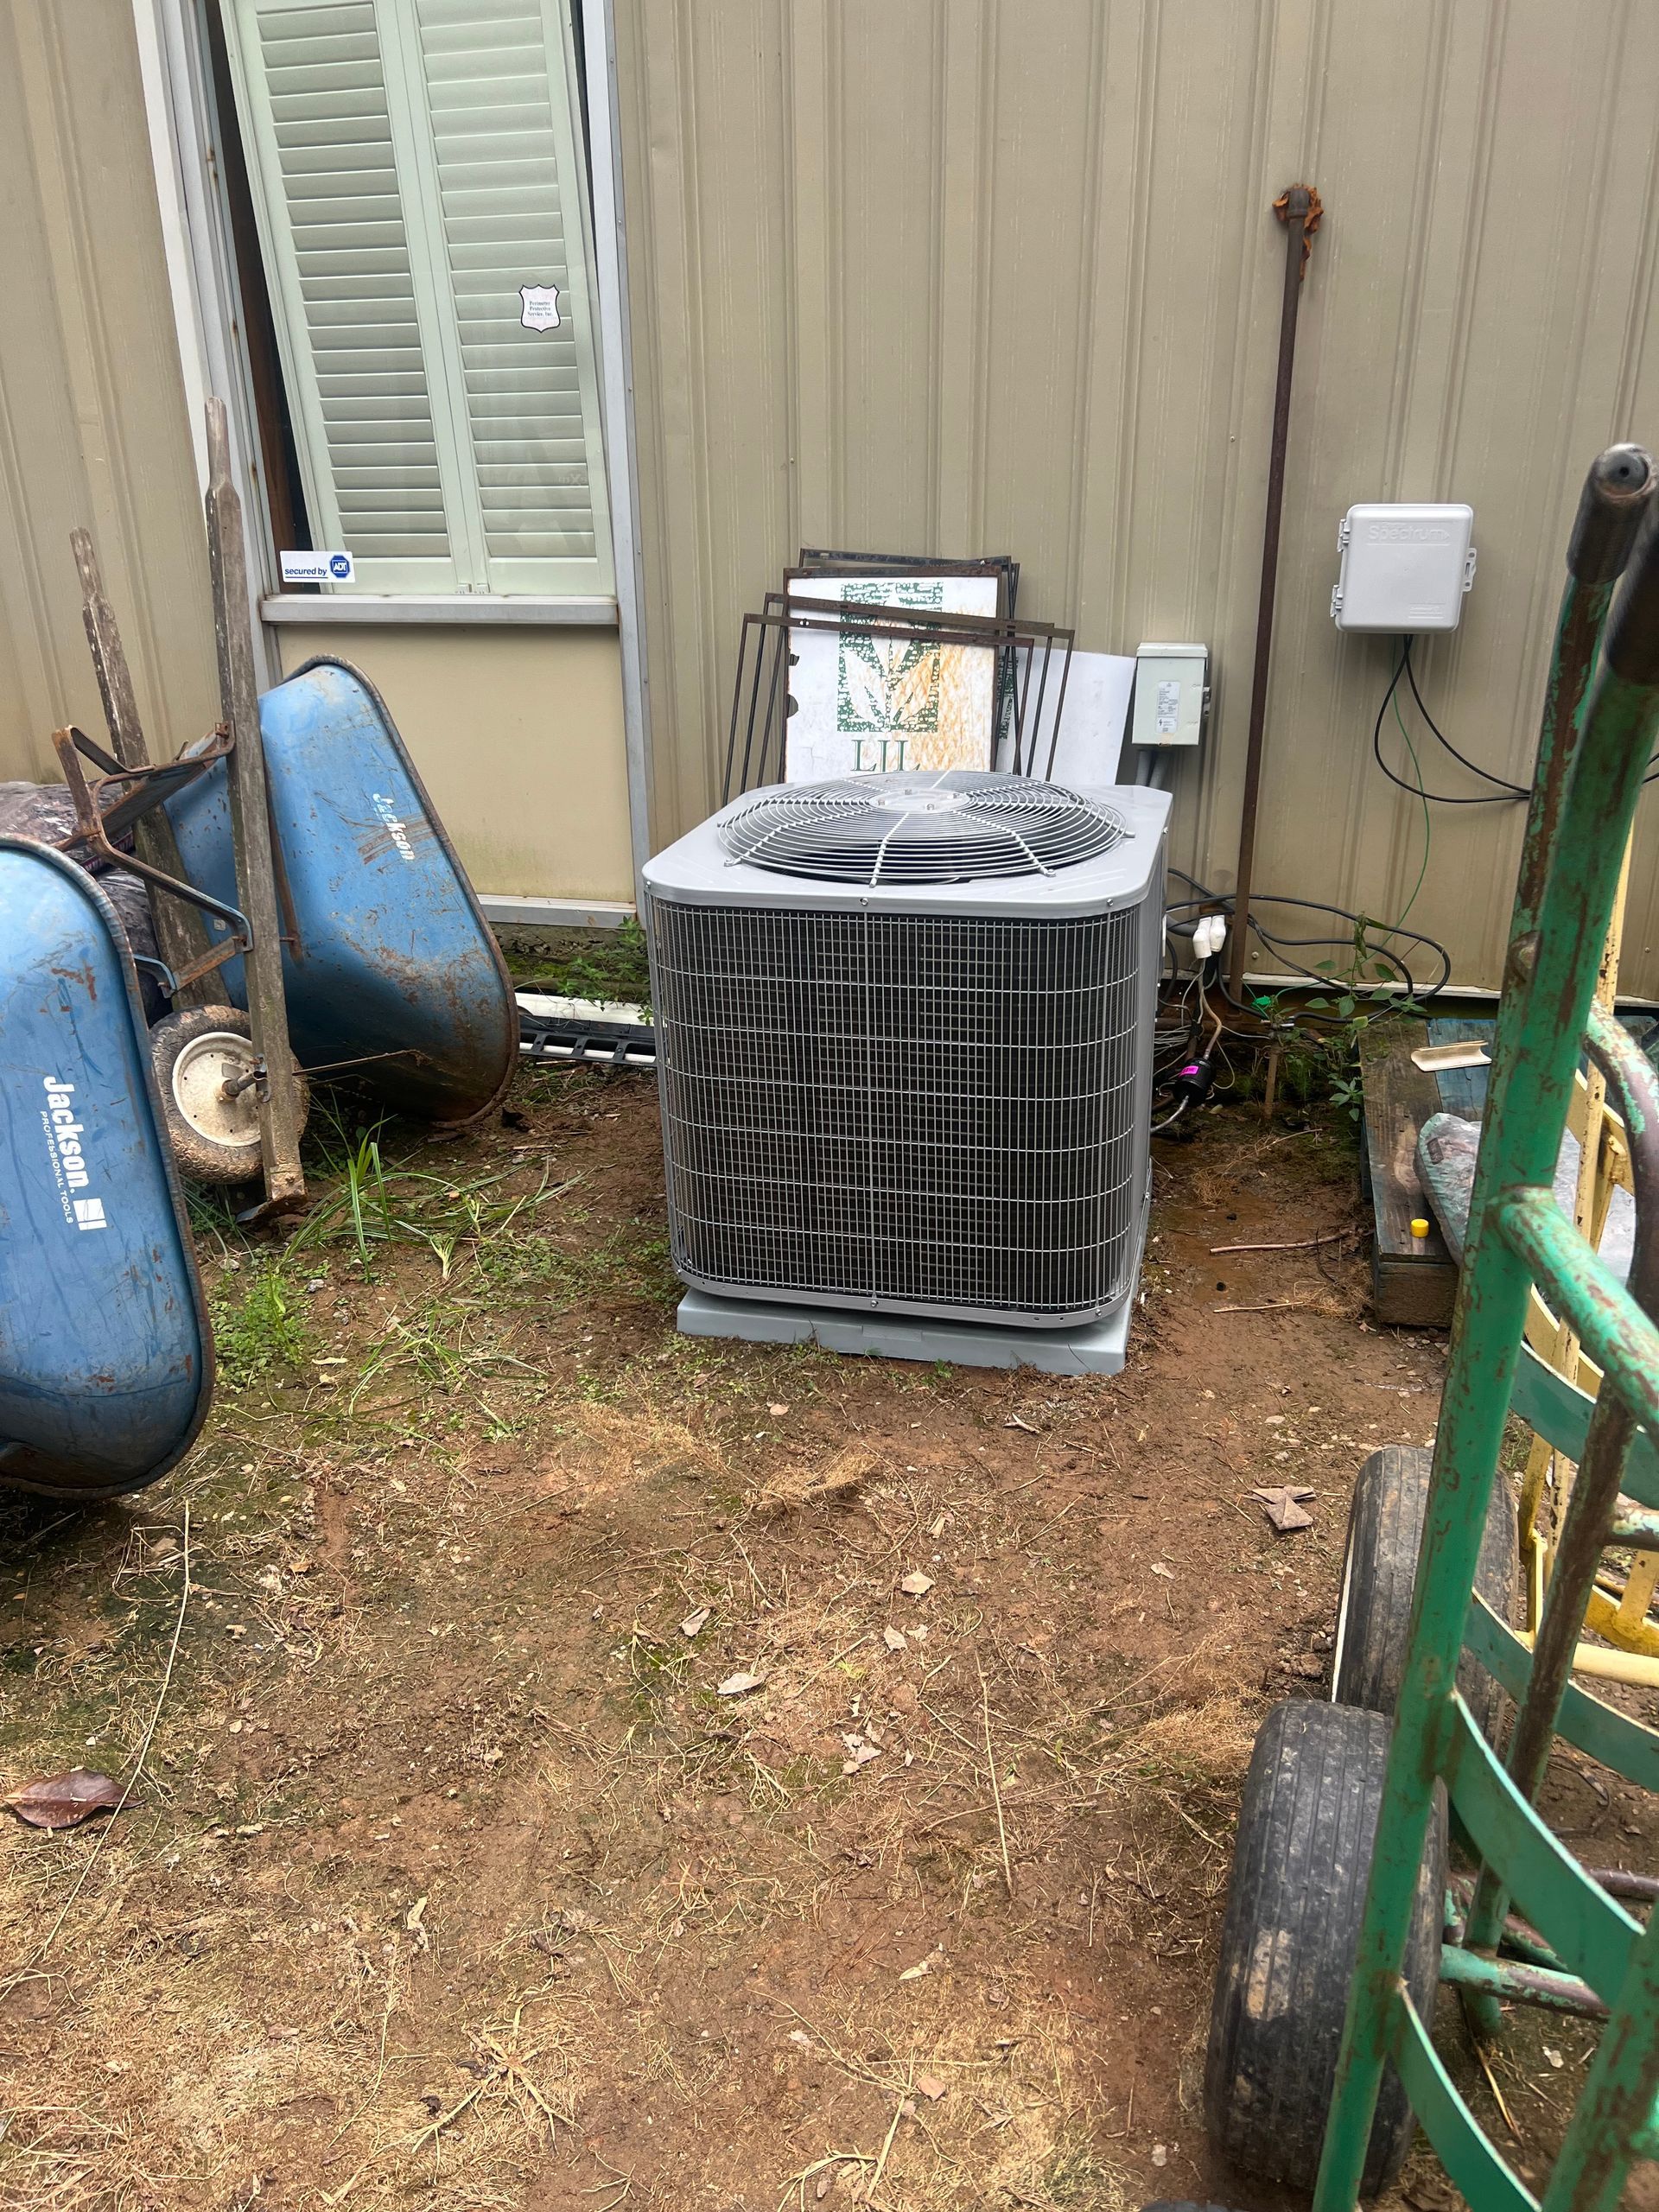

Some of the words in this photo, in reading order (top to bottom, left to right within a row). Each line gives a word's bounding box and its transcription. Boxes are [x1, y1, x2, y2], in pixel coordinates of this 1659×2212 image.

[1368, 525, 1446, 542] Spectrum
[317, 568, 327, 576] by
[334, 563, 346, 572] ADT
[40, 1110, 65, 1189] PROFESSIONAL
[60, 1190, 74, 1224] TOOLS
